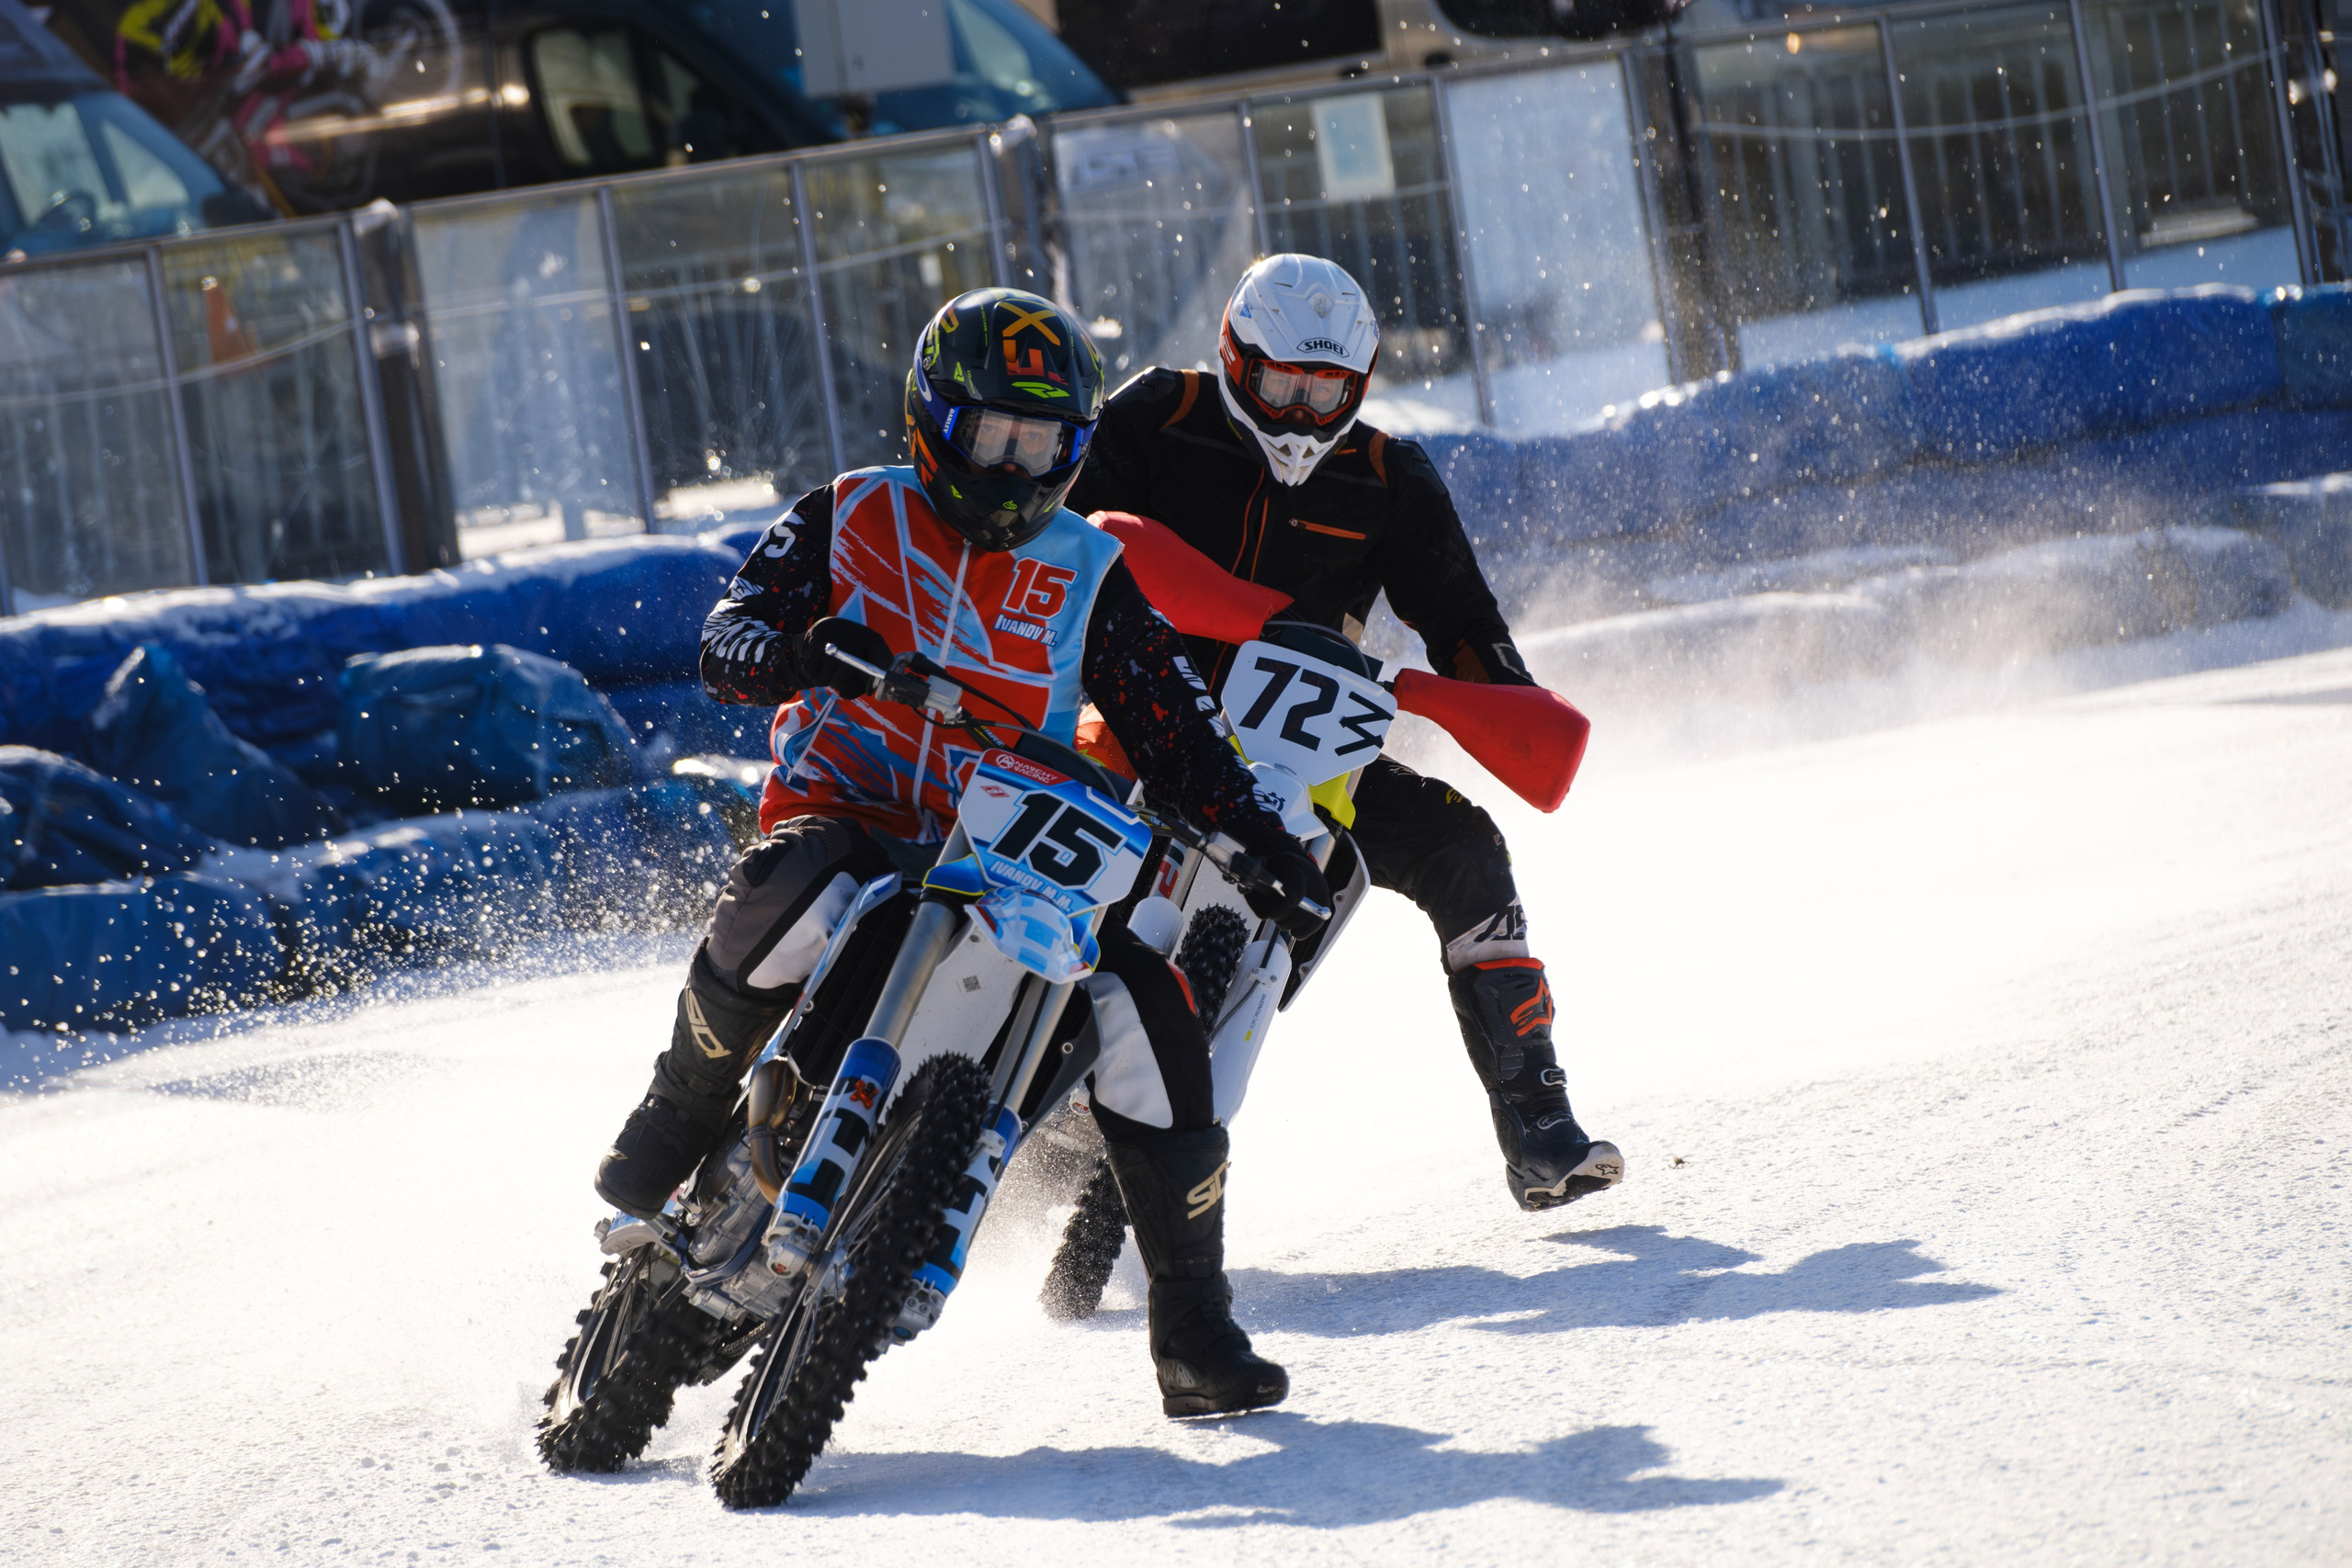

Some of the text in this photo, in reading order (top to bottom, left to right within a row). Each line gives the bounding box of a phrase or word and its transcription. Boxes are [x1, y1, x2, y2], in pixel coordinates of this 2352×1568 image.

[1304, 339, 1344, 355] SHOEI
[943, 408, 955, 434] OAKLEY
[1002, 557, 1078, 620] 15
[1041, 628, 1057, 647] M.
[1013, 765, 1052, 784] RACING
[992, 791, 1125, 887] 15
